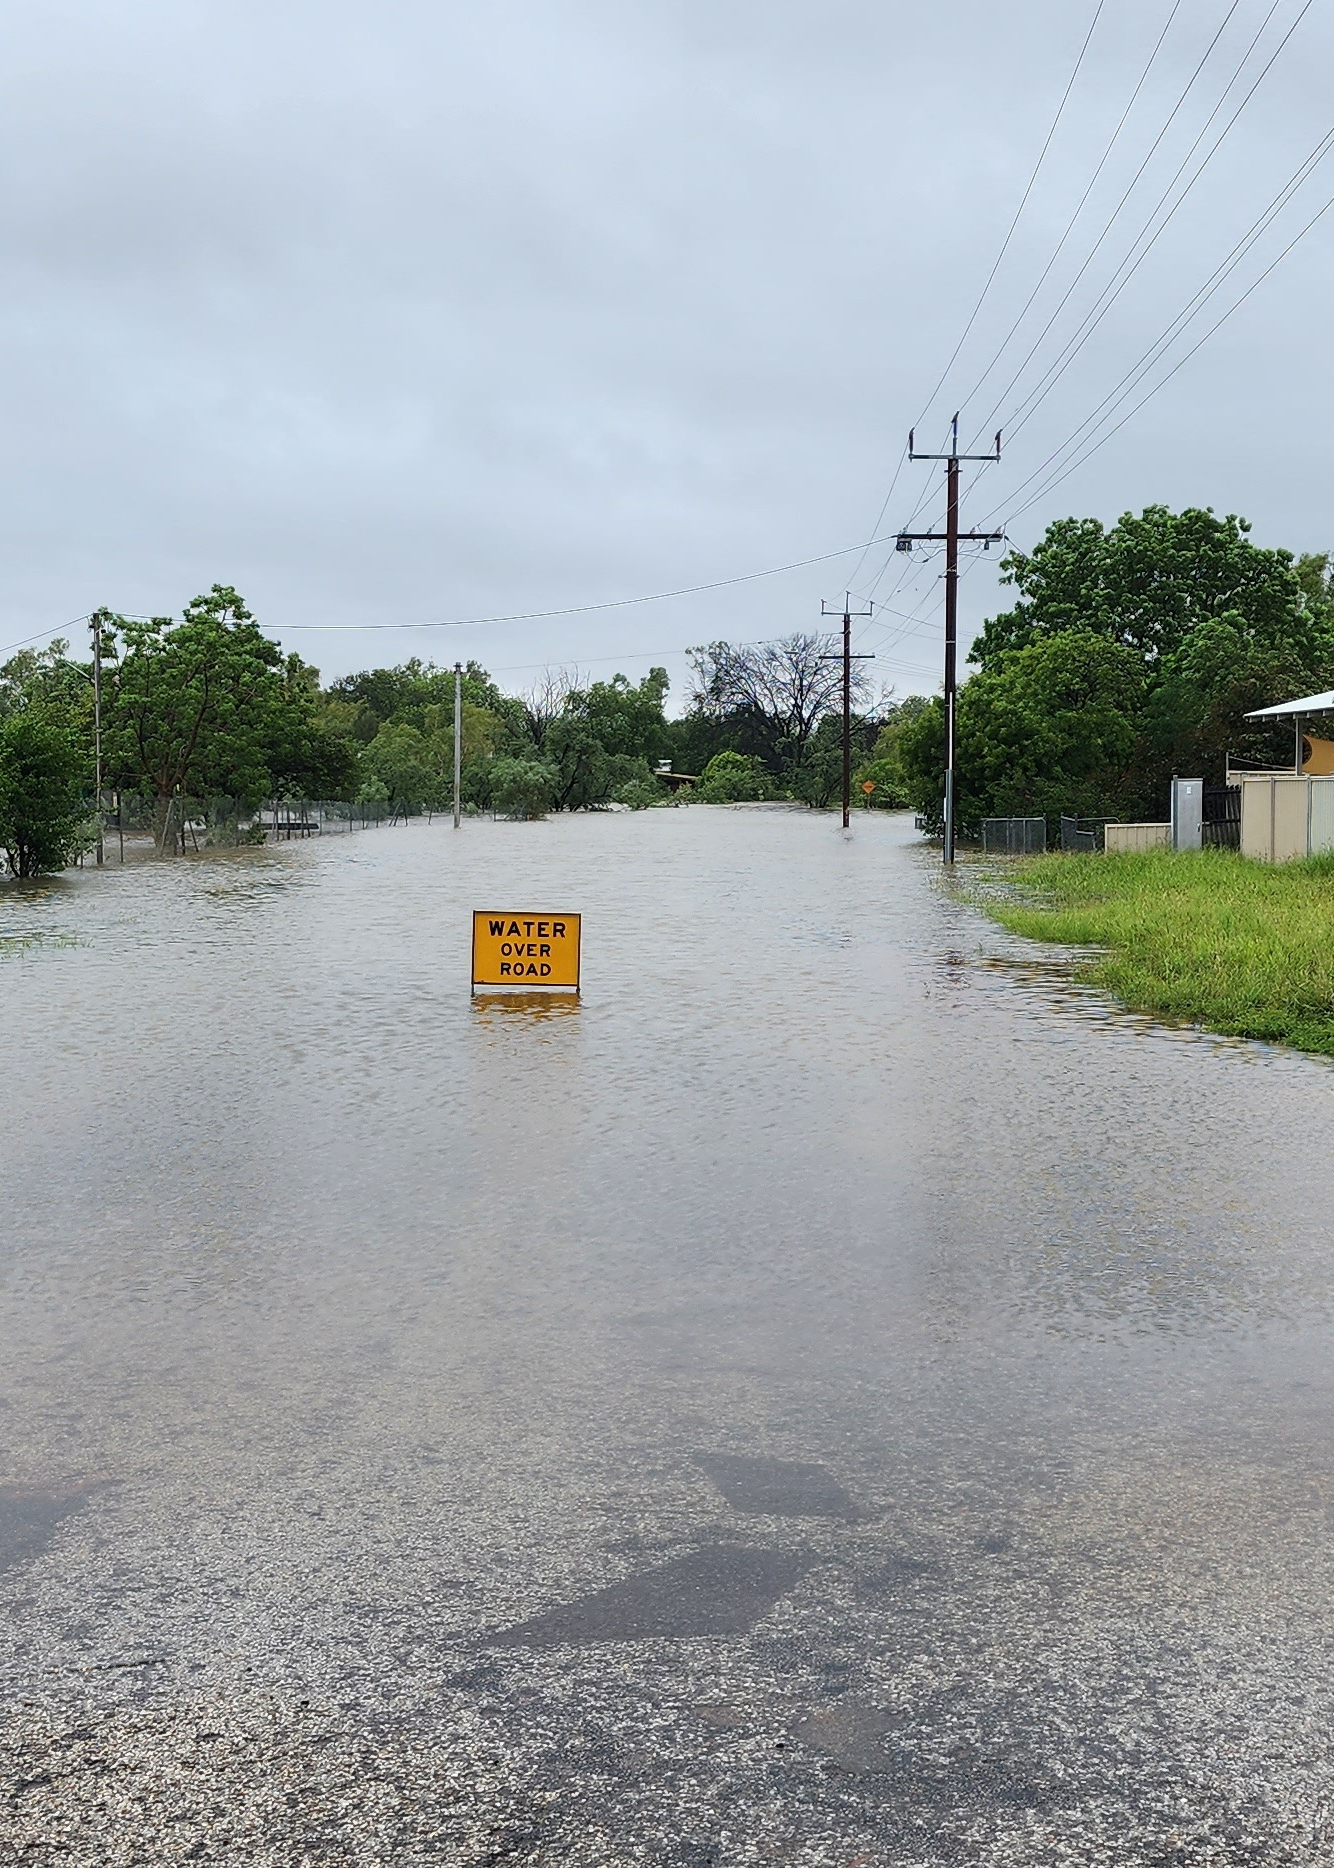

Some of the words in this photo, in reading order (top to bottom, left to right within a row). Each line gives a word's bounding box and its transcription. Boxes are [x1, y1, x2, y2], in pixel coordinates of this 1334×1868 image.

[488, 920, 566, 938] WATER
[500, 942, 551, 957] OVER
[500, 962, 552, 976] ROAD
